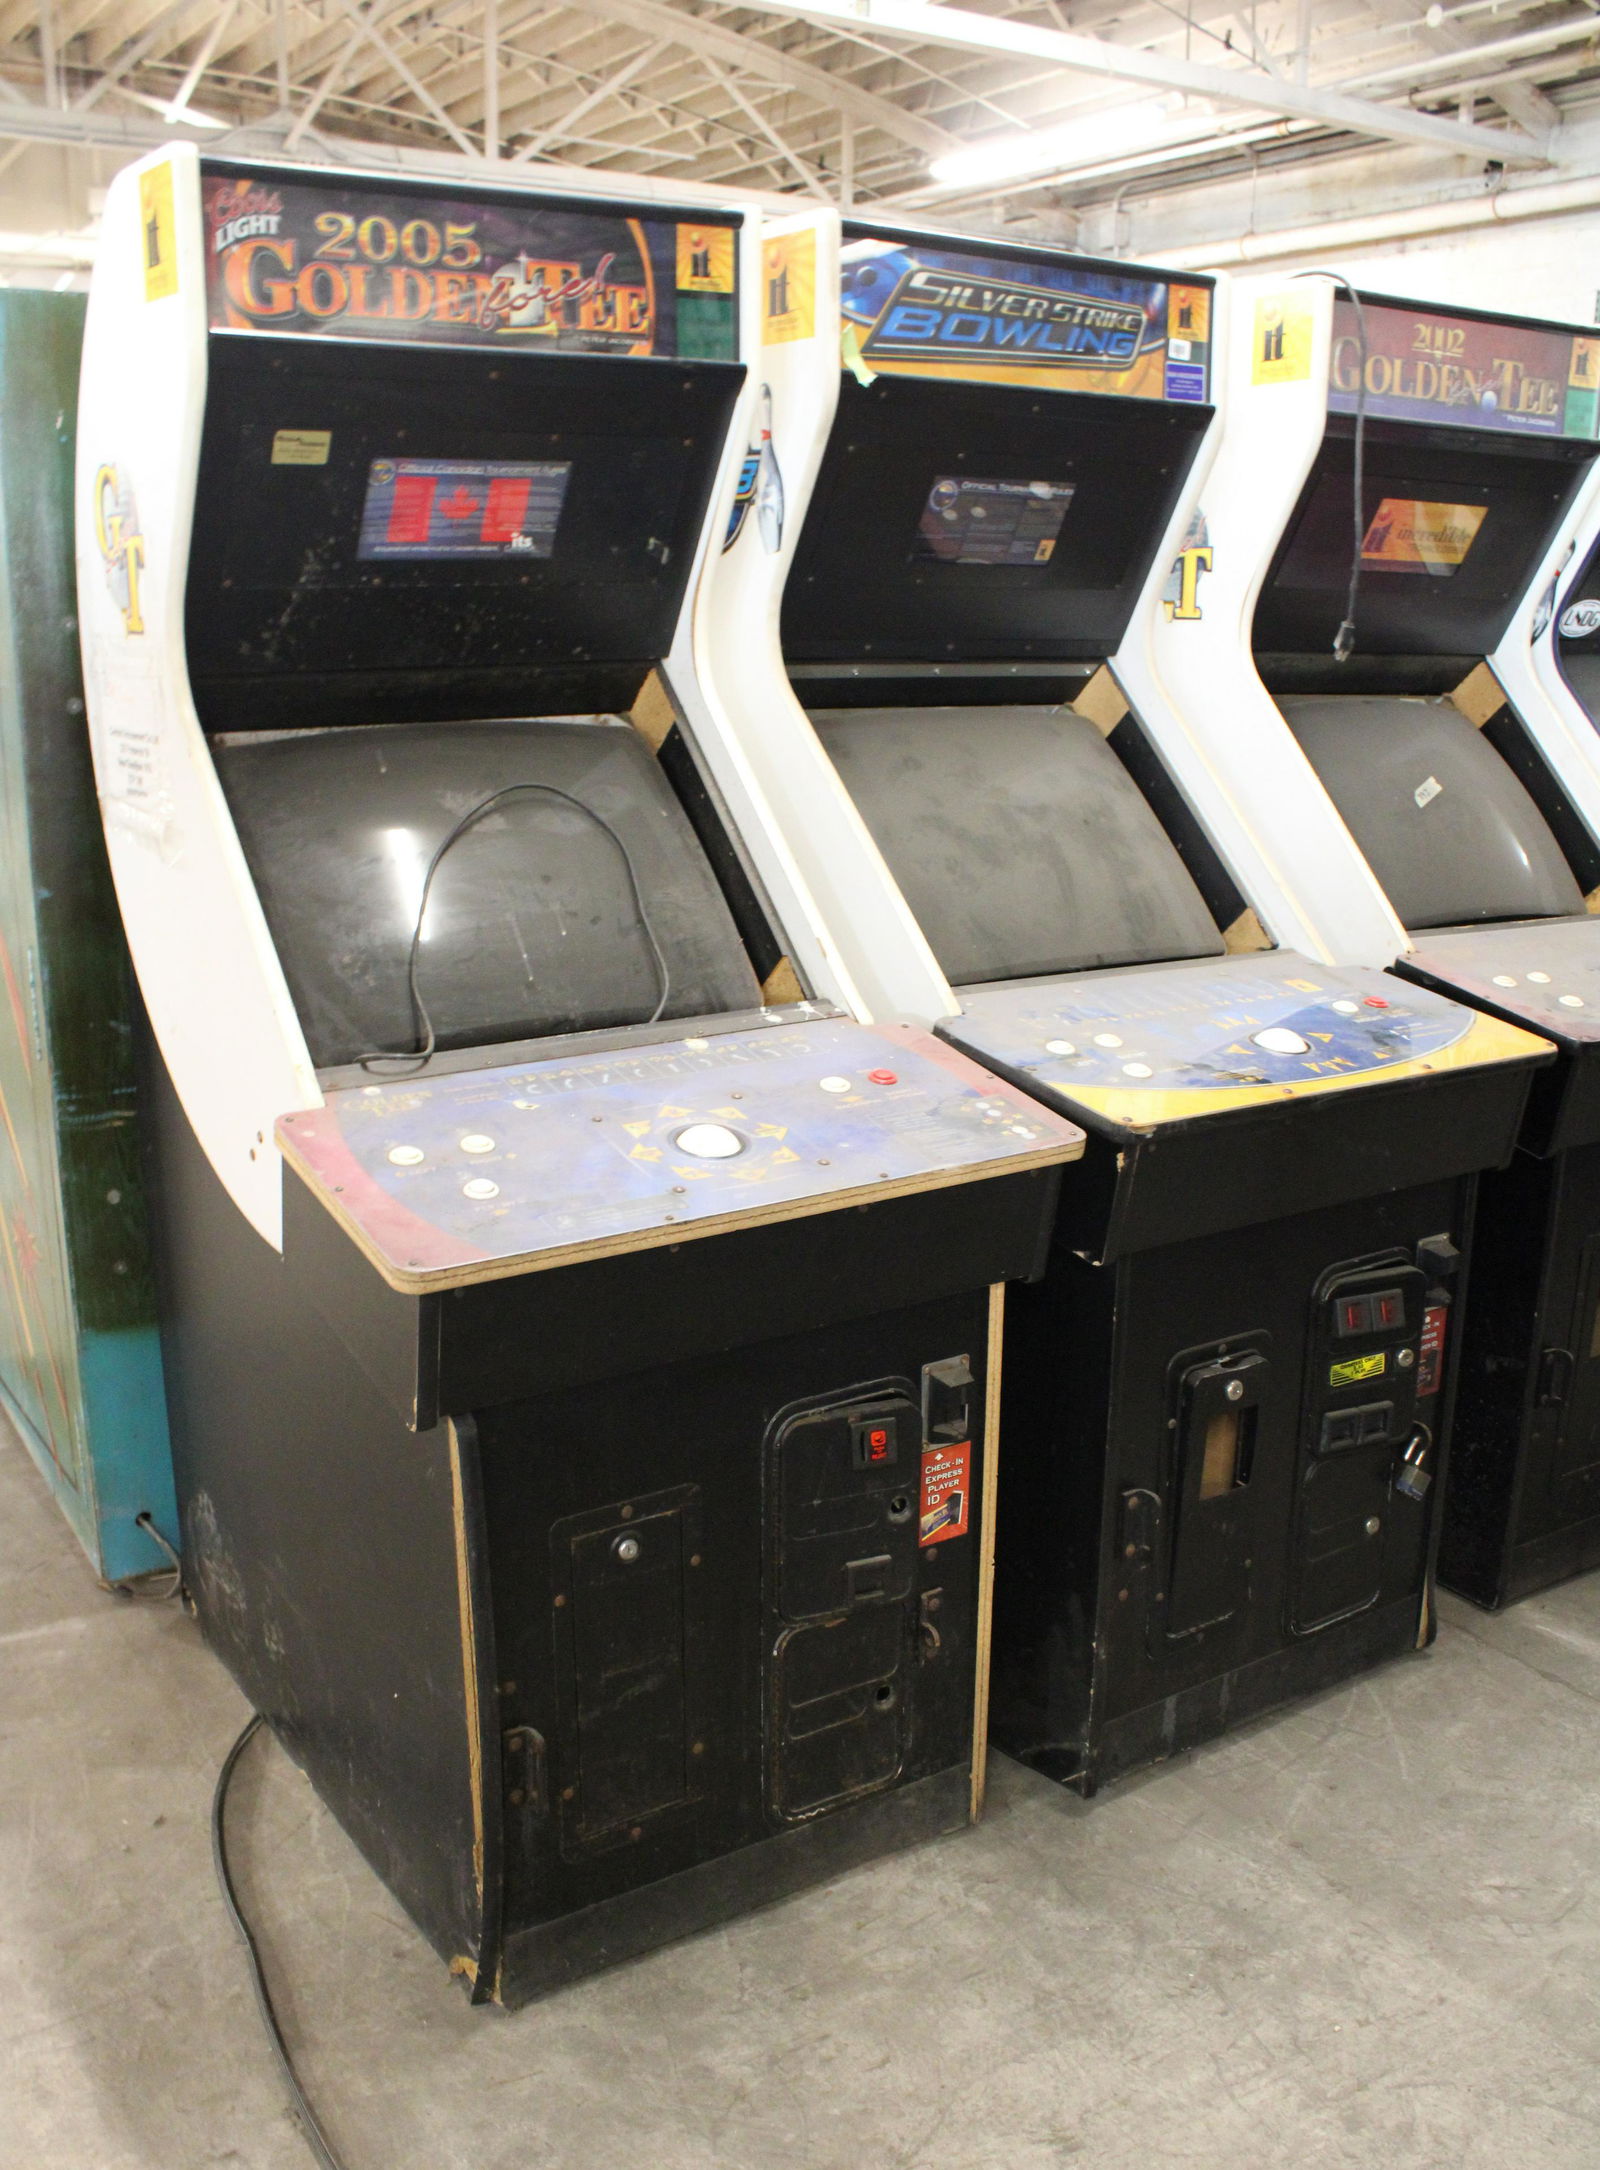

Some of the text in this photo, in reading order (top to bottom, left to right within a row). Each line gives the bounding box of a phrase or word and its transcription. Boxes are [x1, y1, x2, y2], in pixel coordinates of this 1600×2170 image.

[211, 187, 284, 224] Coors
[215, 215, 281, 251] LIGHT
[313, 211, 482, 269] 2005
[224, 238, 650, 334] GOLDEN TEE
[901, 271, 1144, 332] SILVER STRIKE
[879, 306, 1139, 356] BOWLING
[1332, 336, 1560, 416] GOLDEN TEE
[925, 1468, 963, 1485] EXPRESS
[928, 1479, 960, 1494] PLAYER
[927, 1494, 940, 1506] ID
